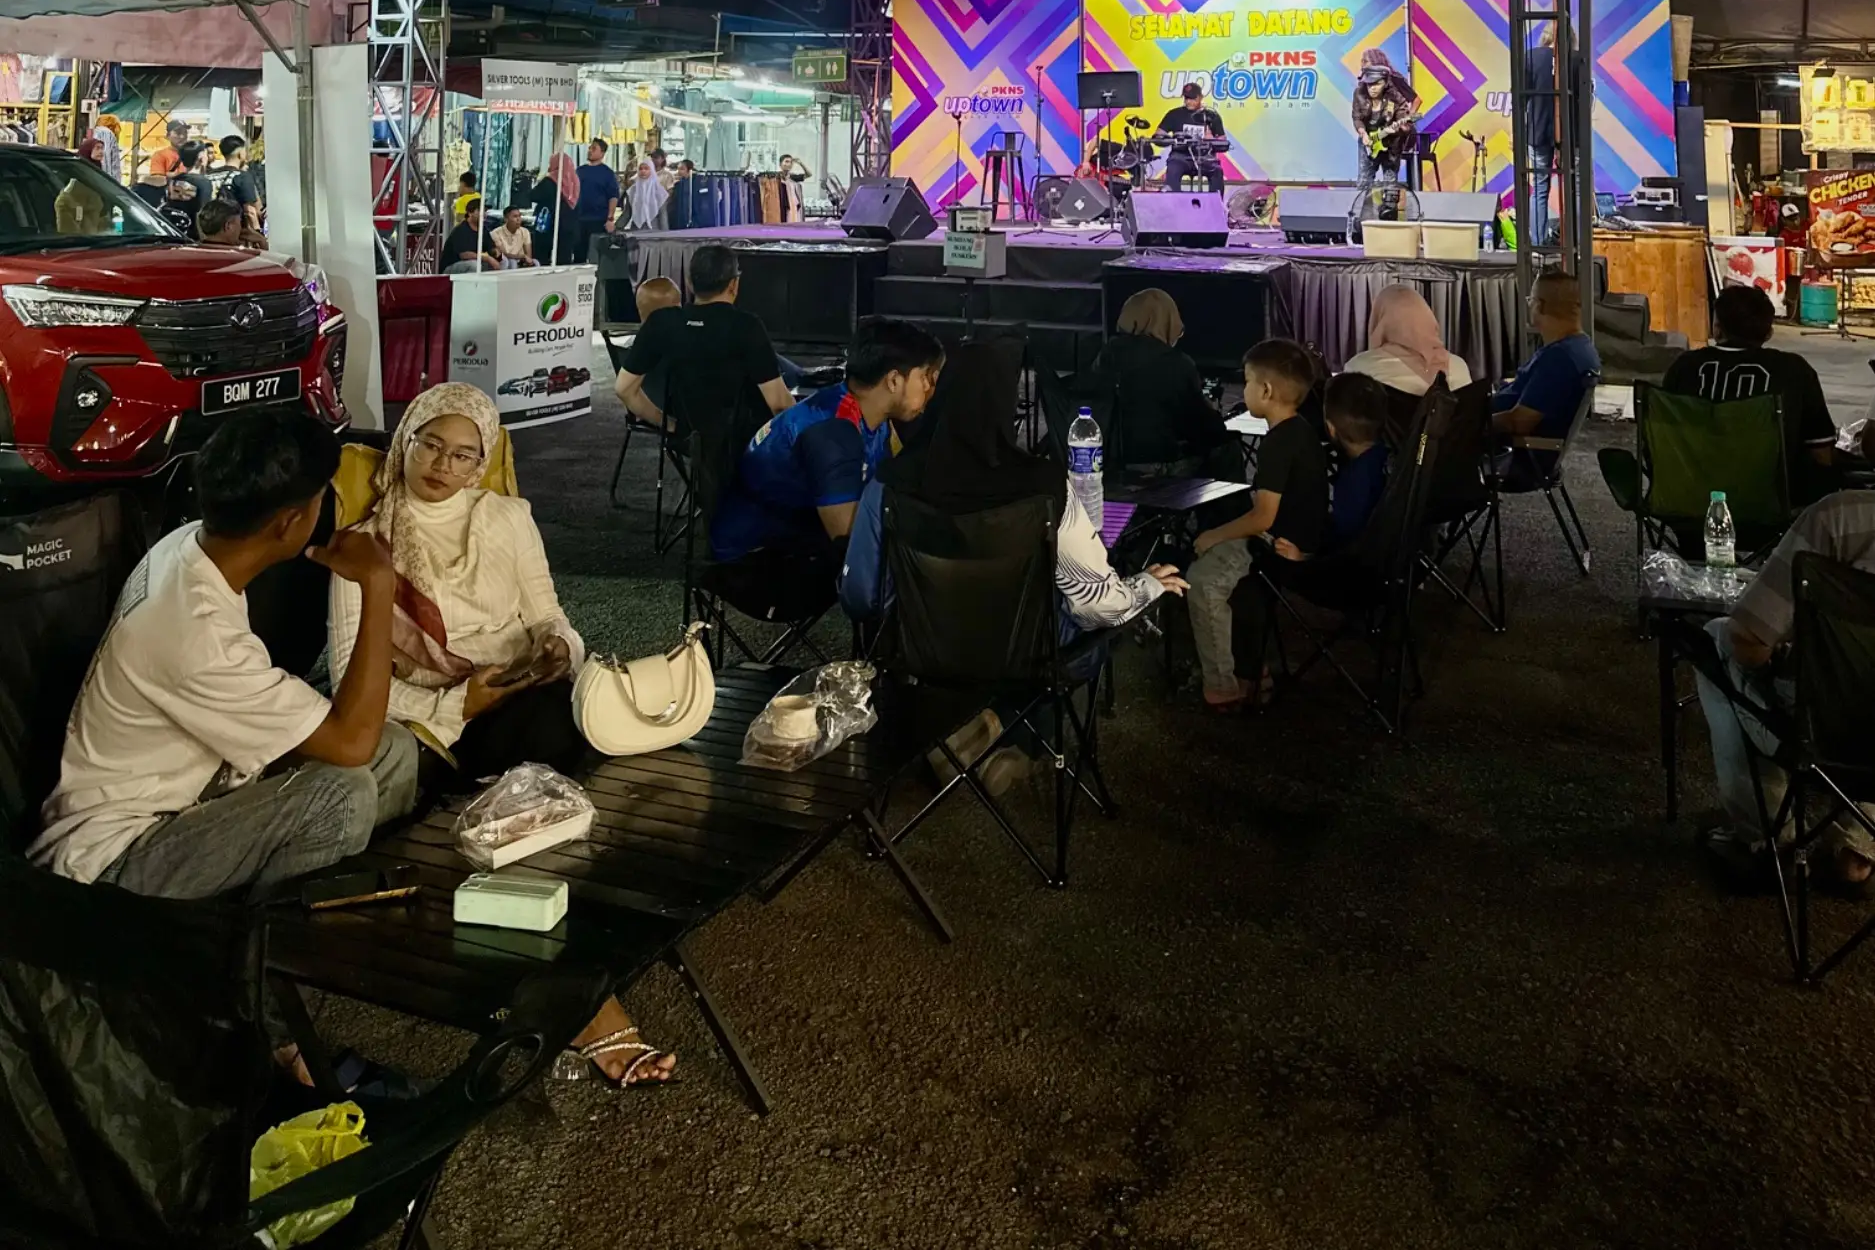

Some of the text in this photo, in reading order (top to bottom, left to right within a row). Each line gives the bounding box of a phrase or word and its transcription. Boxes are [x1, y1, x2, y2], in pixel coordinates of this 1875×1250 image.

[1129, 8, 1353, 41] SELAMAT DATANG
[1249, 51, 1317, 67] PKNS
[487, 73, 509, 84] SILVER
[510, 75, 531, 85] TOOLS
[532, 76, 544, 87] (M)
[560, 77, 574, 87] BHD
[1160, 60, 1318, 100] uptown
[991, 86, 1024, 95] PKNS
[944, 94, 1024, 114] uptown
[1809, 173, 1875, 204] CHICKEN
[1838, 191, 1868, 206] TENDER
[223, 376, 280, 404] BQM 277
[27, 538, 64, 556] MAGIC
[26, 549, 72, 569] POCKET
